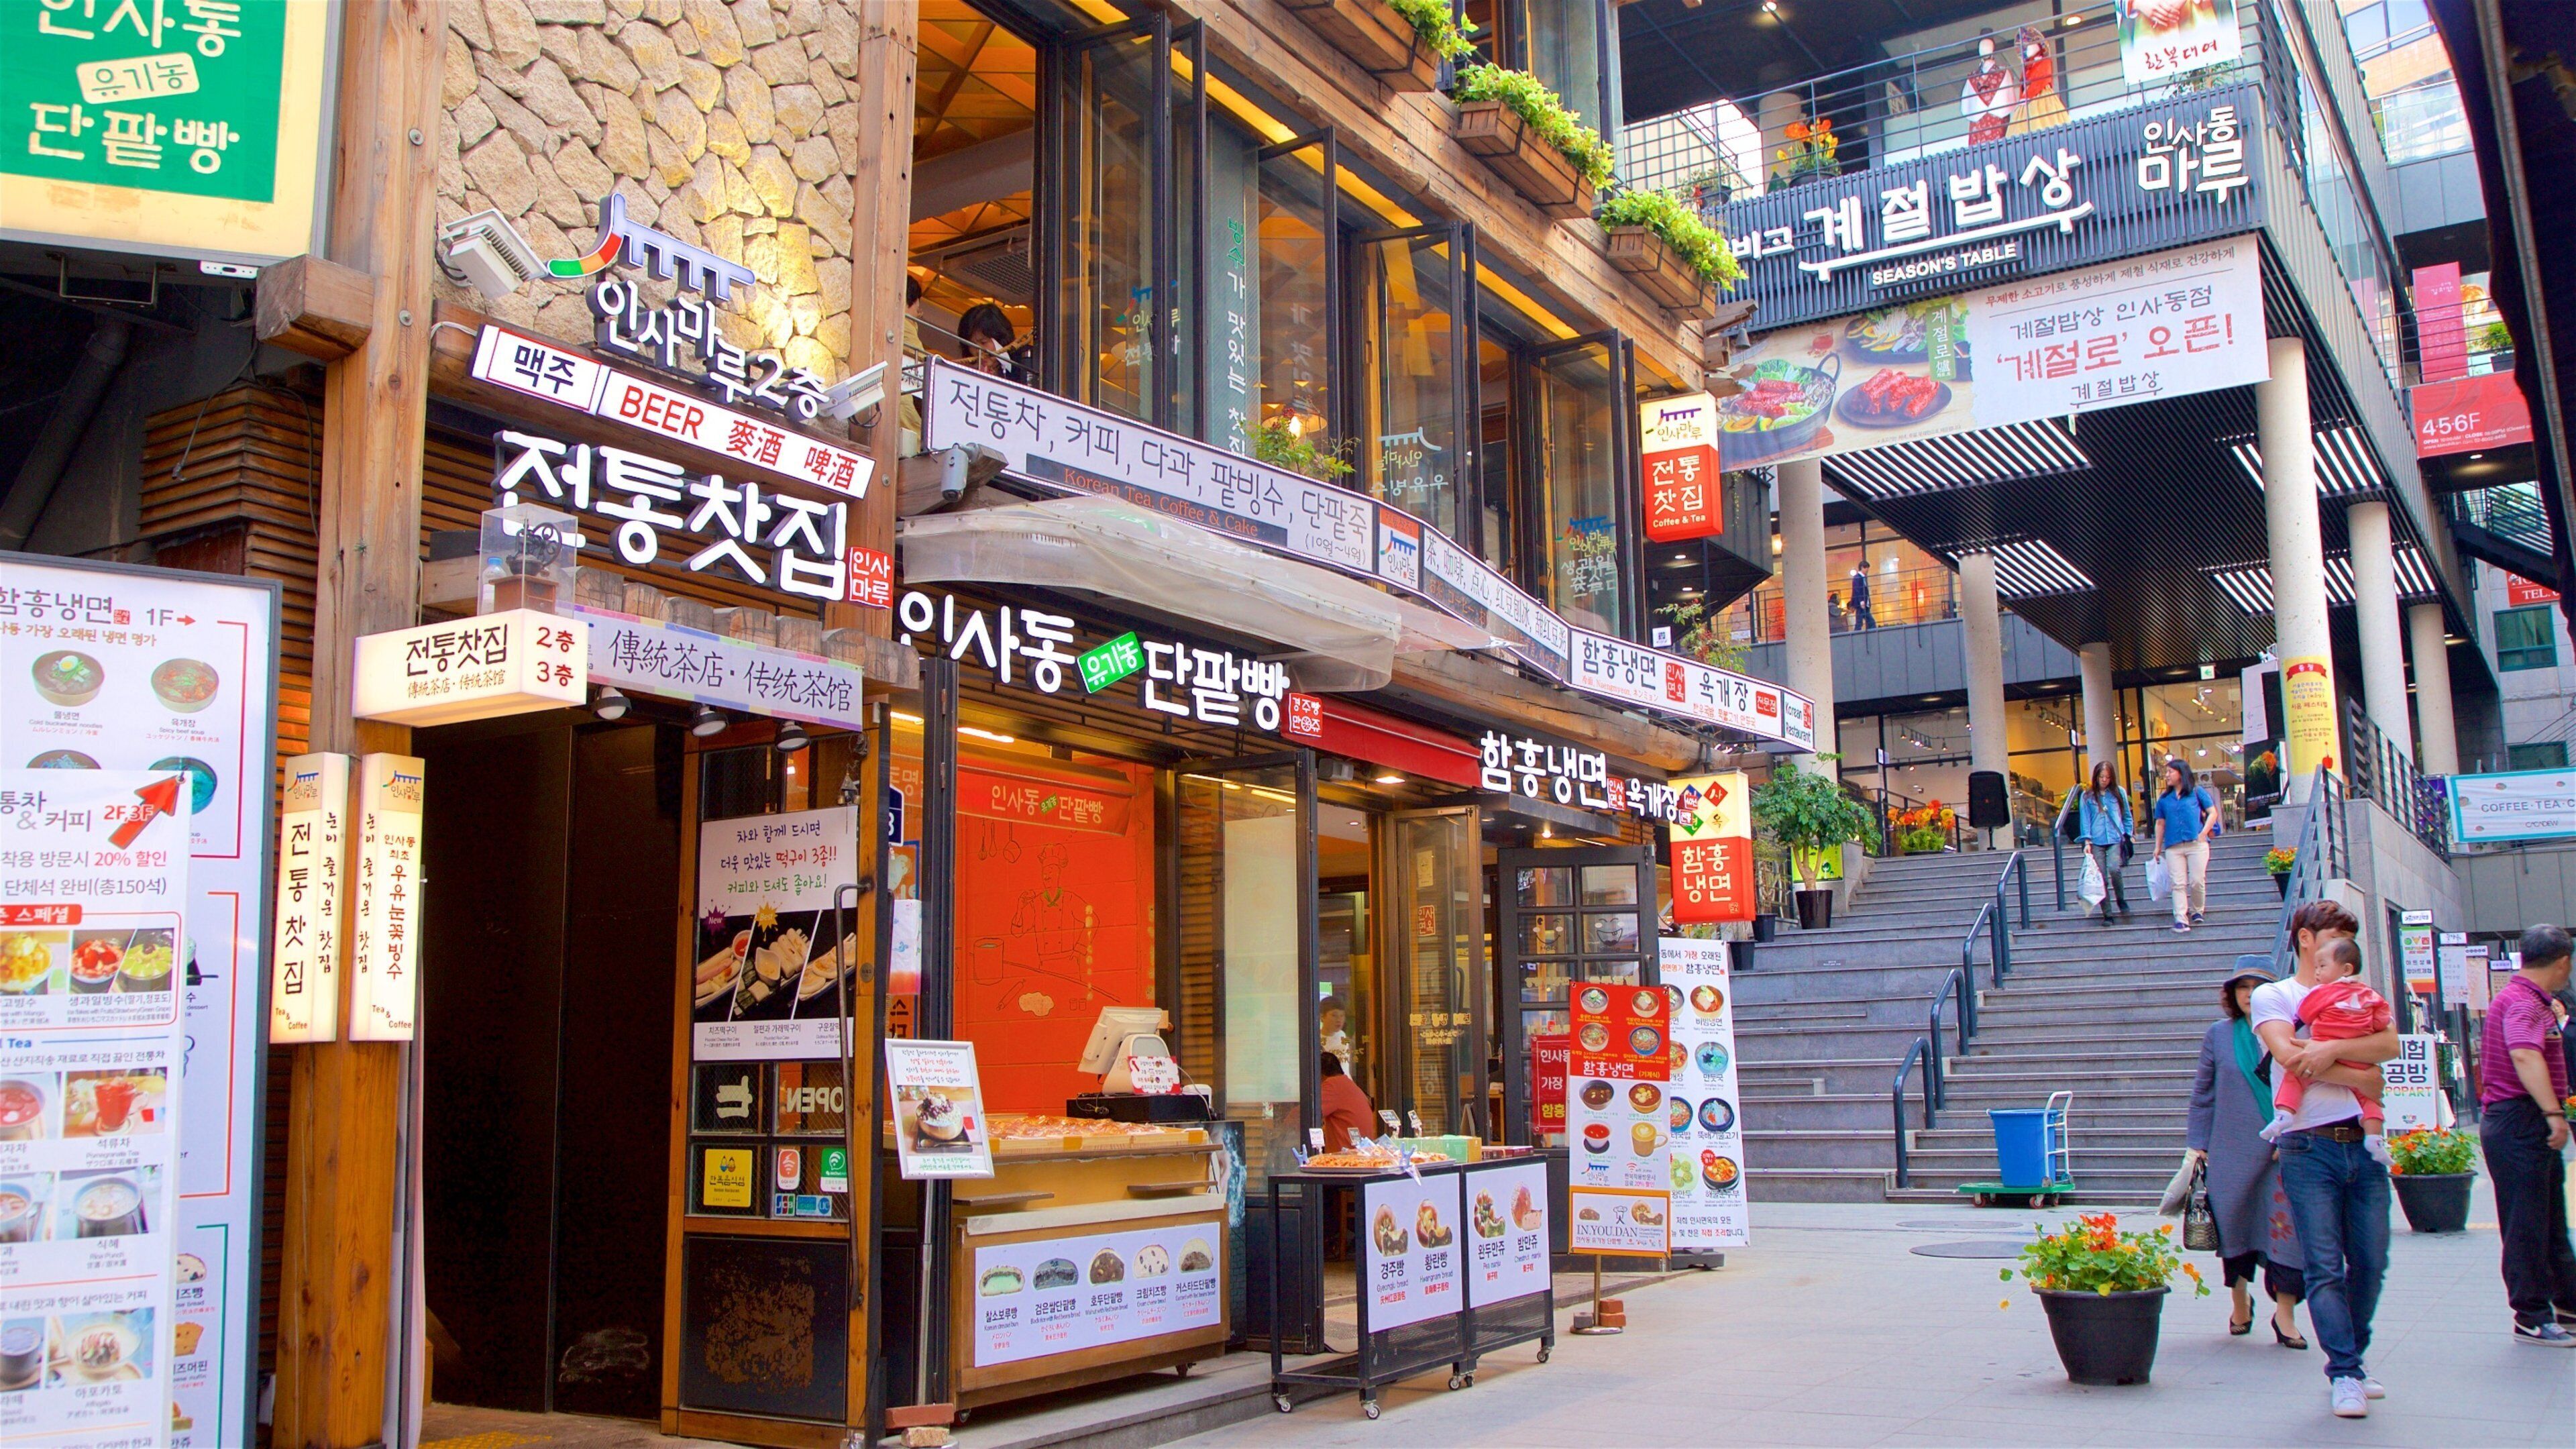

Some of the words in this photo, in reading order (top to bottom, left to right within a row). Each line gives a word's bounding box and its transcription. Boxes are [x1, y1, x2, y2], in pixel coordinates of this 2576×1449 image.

[2145, 39, 2218, 71] 한복대여
[92, 60, 189, 97] 유기농
[28, 102, 240, 174] 단팥빵
[2143, 105, 2237, 154] 인사동
[2138, 138, 2249, 204] 마루
[1802, 148, 2084, 258] 계절밥상
[1872, 256, 1957, 286] SEASON'S
[1960, 243, 2017, 269] TABLE
[2010, 306, 2104, 341] 계절밥상
[2116, 284, 2212, 323] 인사동점
[2143, 313, 2234, 358] 오픈!
[513, 345, 577, 395] 맥주
[2070, 371, 2161, 404] 계절밥상
[619, 386, 704, 440] BEER
[727, 419, 786, 467] 麥酒
[804, 446, 858, 491] 啤酒
[1657, 423, 1703, 441] 인사마루
[1652, 455, 1701, 486] 전통
[1064, 468, 1120, 497] Korean
[1160, 497, 1205, 523] Coffee
[1209, 511, 1220, 526] &
[1224, 515, 1258, 537] Cake
[1653, 486, 1703, 515] 찻집
[499, 430, 847, 601] 전통찻집
[1301, 490, 1367, 543] 단팥죽
[1653, 518, 1679, 528] Coffee
[1690, 514, 1706, 523] Tea
[852, 549, 890, 578] 인사
[1387, 553, 1415, 584] 인사마루
[851, 576, 890, 603] 마루
[146, 608, 174, 626] 1F
[25, 624, 53, 638] 가장
[58, 628, 97, 642] 오래된
[103, 630, 127, 645] 냉면
[132, 633, 157, 647] 명가
[537, 627, 575, 653] 2층
[407, 623, 508, 676] 전통찻집
[900, 591, 1075, 693] 인사동
[1086, 639, 1139, 686] 유기농
[1143, 641, 1289, 730] 단팥빵
[537, 661, 574, 686] 3층
[1583, 637, 1656, 690] 함흥냉면
[1699, 672, 1748, 711] 육개장
[1666, 663, 1685, 683] 인사
[1667, 682, 1685, 701] 면옥
[1292, 697, 1321, 715] 경주빵
[1757, 697, 1776, 714] 전문점
[1785, 701, 1803, 720] Korean
[1786, 722, 1811, 743] Restaurant
[1481, 731, 1608, 810] 함흥냉면
[1626, 778, 1679, 822] 육개장
[1609, 780, 1624, 793] 인사
[293, 783, 317, 800] 인사마루
[390, 784, 421, 803] 인사마루
[103, 804, 154, 822] 2F,3F
[991, 785, 1039, 815] 인사동
[1040, 794, 1058, 814] 유기농
[1059, 796, 1104, 824] 단팥빵
[17, 811, 37, 830] &
[45, 809, 91, 833] 커피
[737, 830, 758, 843] 차와
[763, 824, 786, 843] 함께
[792, 820, 820, 837] 드시면
[384, 835, 415, 847] 인사동
[1, 851, 34, 868] 착용
[40, 851, 89, 867] 방문시
[95, 851, 131, 867] 20%
[136, 851, 167, 867] 할인
[390, 850, 409, 860] 최초
[720, 857, 739, 873] 더욱
[744, 852, 771, 870] 맛있는
[775, 850, 806, 866] 떡구이
[1682, 843, 1730, 873] 함흥
[5, 879, 55, 896] 단체석
[728, 879, 759, 894] 커피와
[763, 877, 788, 892] 드셔도
[1683, 873, 1731, 903] 냉면
[15, 906, 70, 923] 스페셜
[708, 916, 722, 925] New
[1684, 950, 1698, 960] 가장
[1701, 951, 1721, 961] 오래된
[1686, 963, 1720, 975] 함흥냉면
[275, 1008, 286, 1016] Tea
[288, 1021, 307, 1030] Coffee
[372, 1006, 384, 1014] Tea
[388, 1020, 412, 1029] Coffee
[9, 1038, 32, 1048] Tea
[136, 1051, 165, 1062] 전통차
[1583, 1061, 1634, 1078] 함흥냉면
[2386, 1063, 2428, 1083] 공방
[1541, 1076, 1562, 1090] 가장
[2385, 1086, 2432, 1097] POPART
[1542, 1103, 1565, 1118] 함흥
[1576, 1224, 1638, 1237] IN.YOU.DAN
[1478, 1241, 1505, 1259] 완두만쥬
[1517, 1234, 1538, 1251] 밤만쥬
[1381, 1260, 1404, 1280] 경주빵
